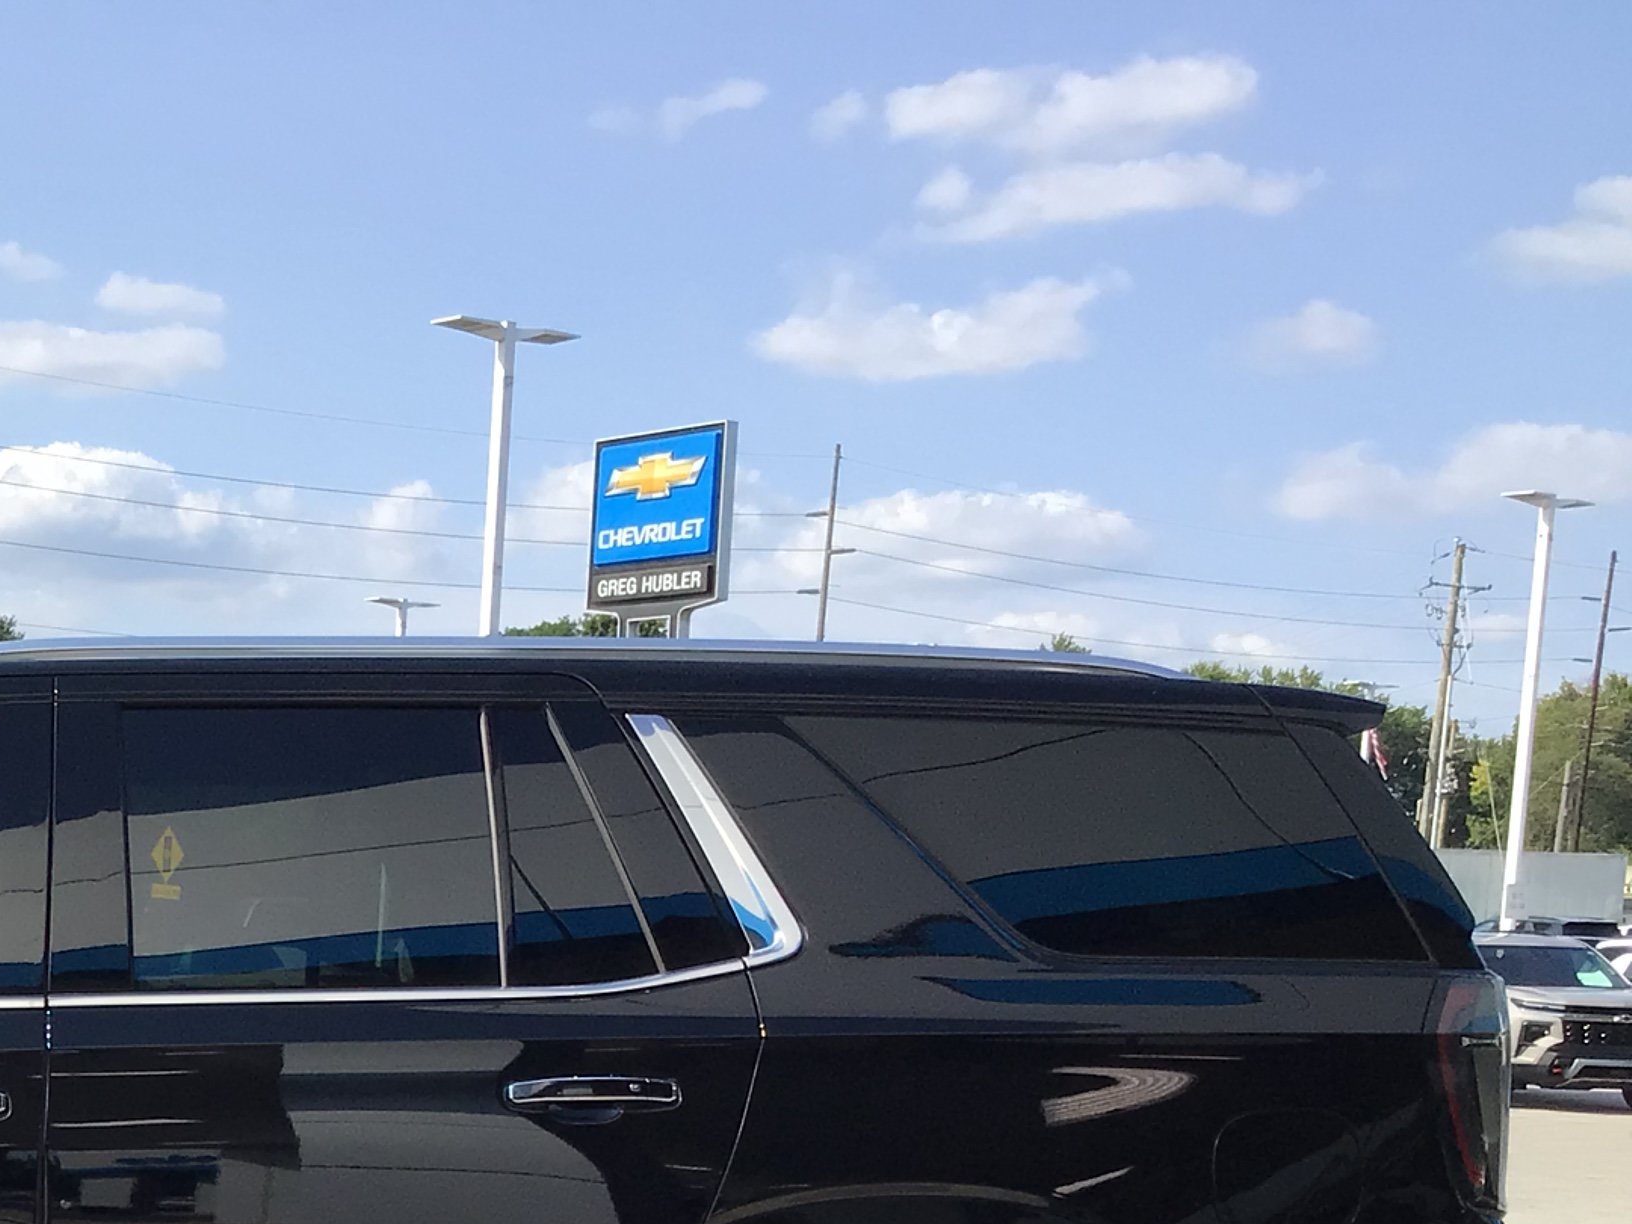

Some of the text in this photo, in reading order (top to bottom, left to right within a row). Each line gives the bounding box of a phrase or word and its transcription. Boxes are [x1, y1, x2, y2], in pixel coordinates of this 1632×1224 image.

[598, 518, 705, 549] CHEVROLET
[597, 571, 702, 597] GREG HUBLER
